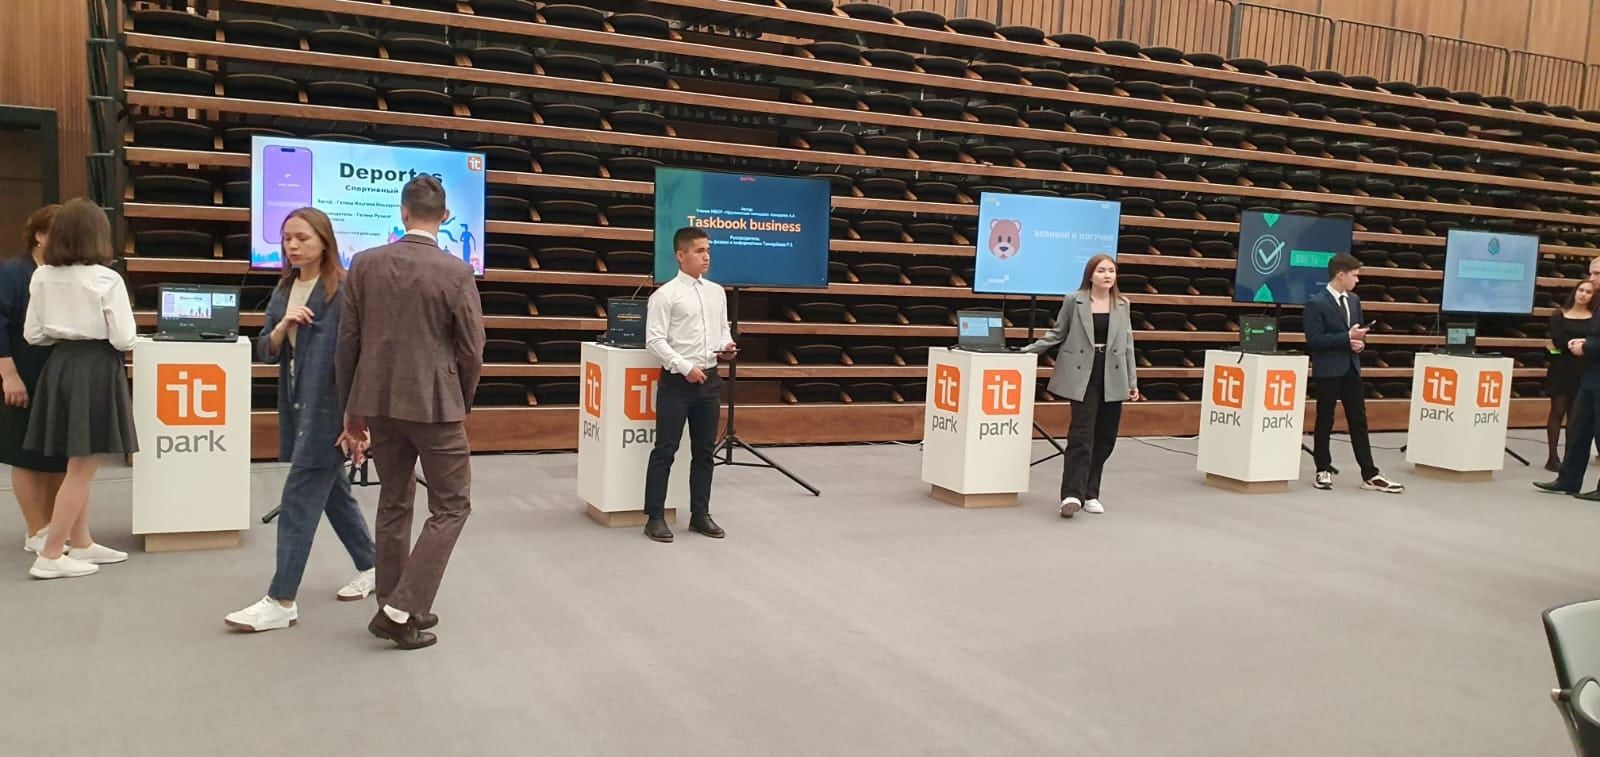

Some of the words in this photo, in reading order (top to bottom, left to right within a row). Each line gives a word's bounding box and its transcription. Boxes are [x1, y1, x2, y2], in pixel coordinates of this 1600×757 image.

[339, 162, 443, 183] Deports
[345, 185, 399, 194] Спортивный
[686, 215, 747, 231] Taskbook
[749, 218, 801, 233] business
[165, 370, 218, 418] it
[586, 368, 599, 411] it
[938, 370, 957, 407] it
[987, 375, 1017, 410] it
[1217, 370, 1240, 404] it
[1269, 374, 1292, 406] it
[1428, 371, 1453, 402] it
[1481, 375, 1500, 404] it
[931, 415, 958, 434] park
[1210, 410, 1241, 427] park
[1261, 413, 1294, 433] park
[1420, 407, 1454, 423] park
[1474, 410, 1500, 428] park
[583, 420, 600, 441] park
[622, 427, 657, 449] par
[979, 418, 1020, 440] park
[156, 429, 227, 459] park
